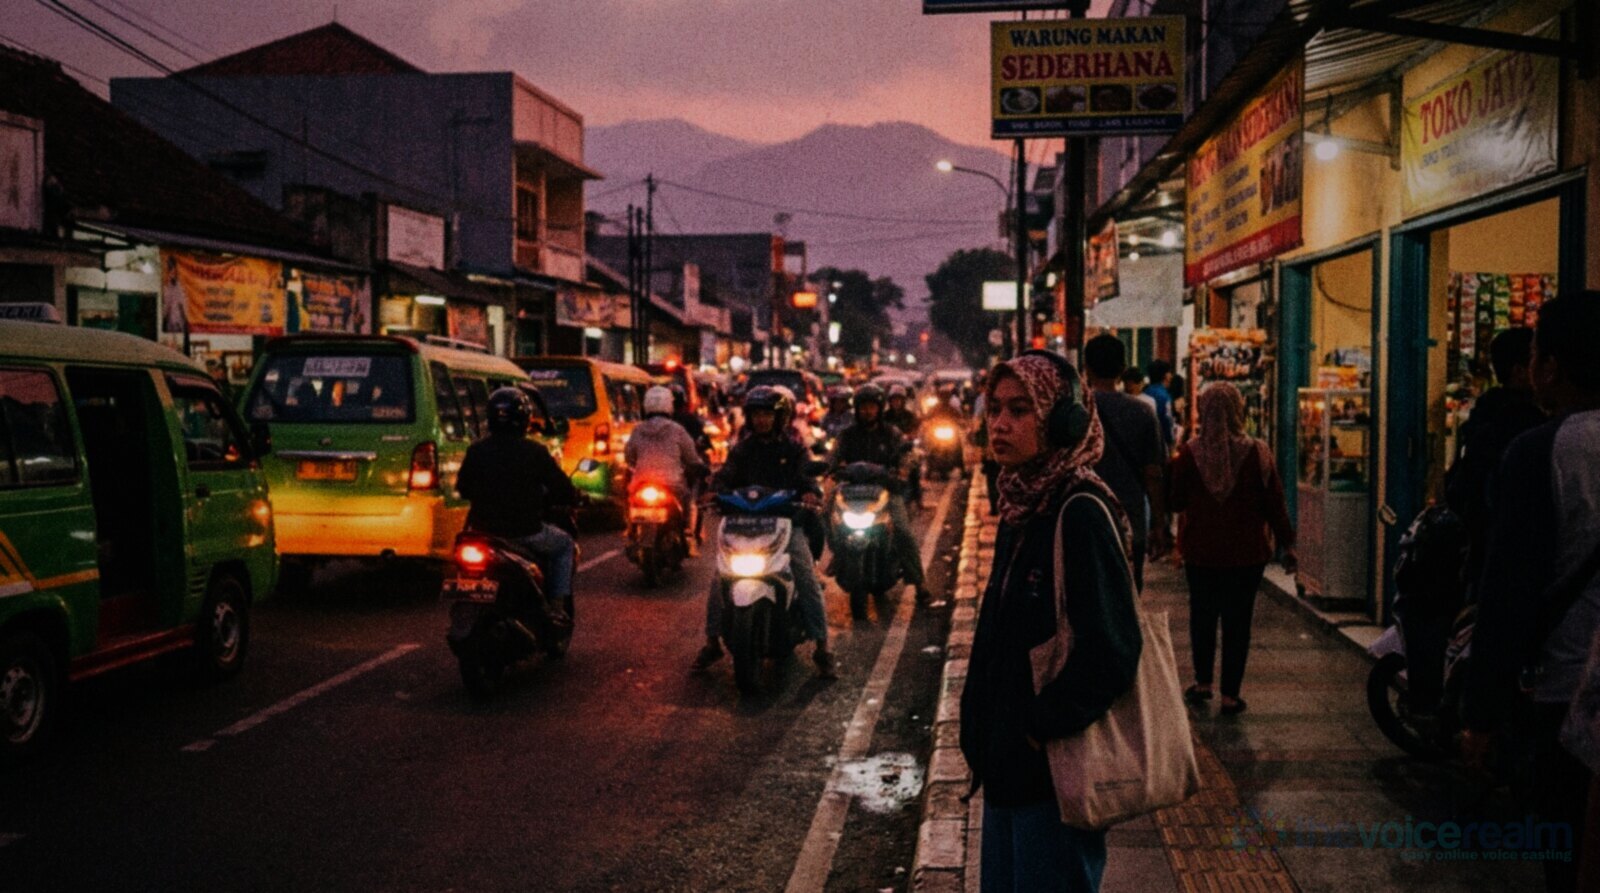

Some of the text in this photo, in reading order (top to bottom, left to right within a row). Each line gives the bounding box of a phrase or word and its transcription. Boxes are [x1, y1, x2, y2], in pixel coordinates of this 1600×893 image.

[1011, 25, 1166, 47] WARUNG MAKAN
[1002, 50, 1174, 81] SEDERHANA
[1420, 50, 1536, 144] TOKO JAYA
